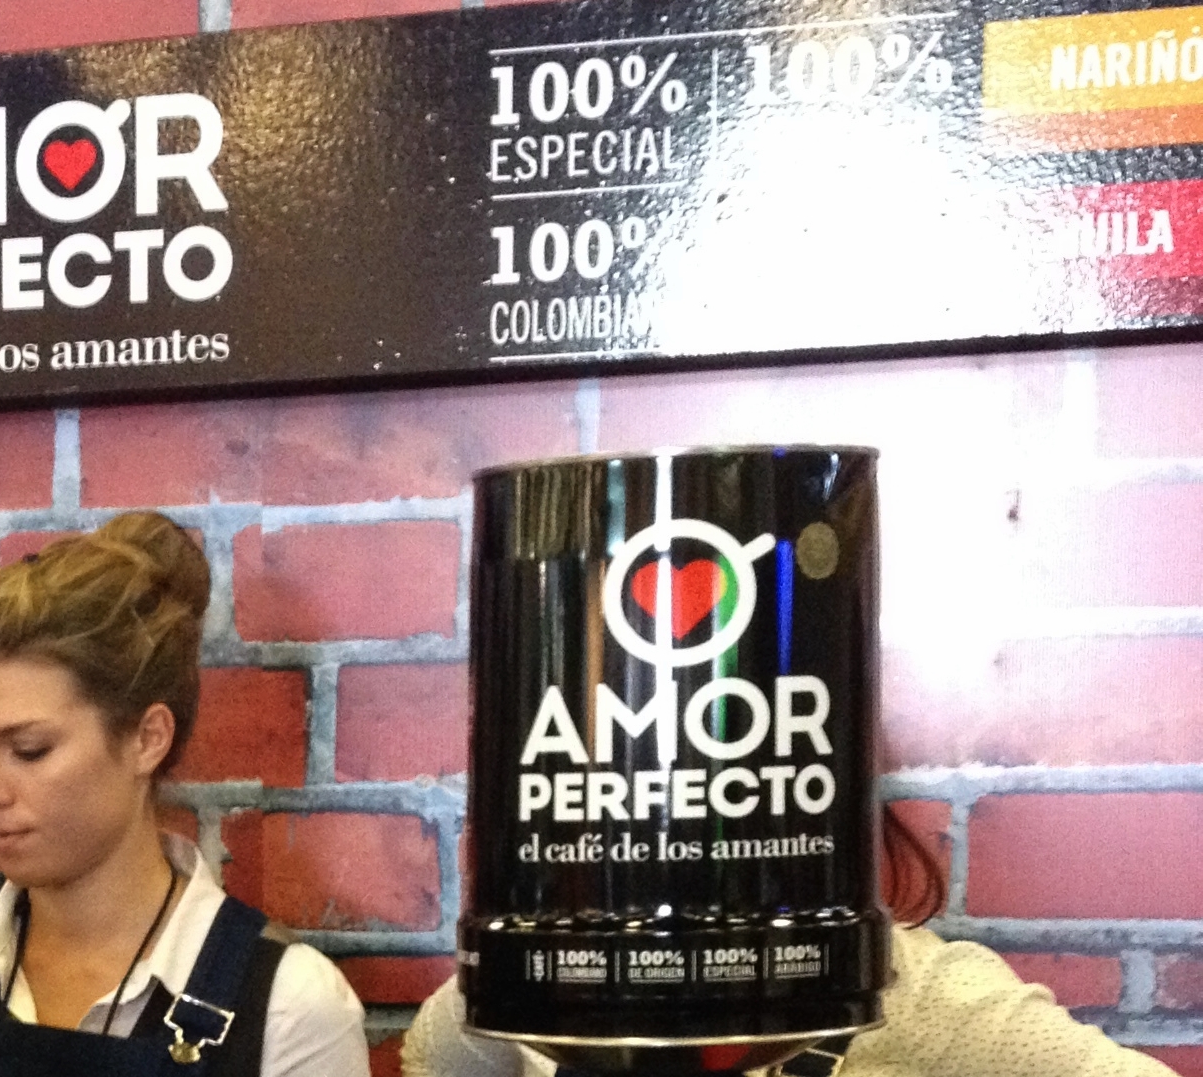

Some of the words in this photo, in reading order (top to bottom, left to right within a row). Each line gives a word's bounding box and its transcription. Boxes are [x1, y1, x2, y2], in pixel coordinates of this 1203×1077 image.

[489, 52, 689, 126] 100%
[745, 31, 954, 104] 100%
[490, 131, 684, 183] ESPECIAL
[1077, 209, 1175, 257] UILA
[50, 329, 230, 371] amantes
[519, 675, 833, 766] AMOR
[518, 763, 836, 822] PERFECTO
[518, 833, 540, 863] el
[545, 832, 604, 863] café
[609, 833, 650, 864] de
[655, 831, 703, 862] los
[709, 832, 835, 860] amantes
[556, 949, 608, 966] 100%
[627, 949, 685, 966] 100%
[702, 946, 759, 965] 100%
[773, 944, 822, 962] 100%
